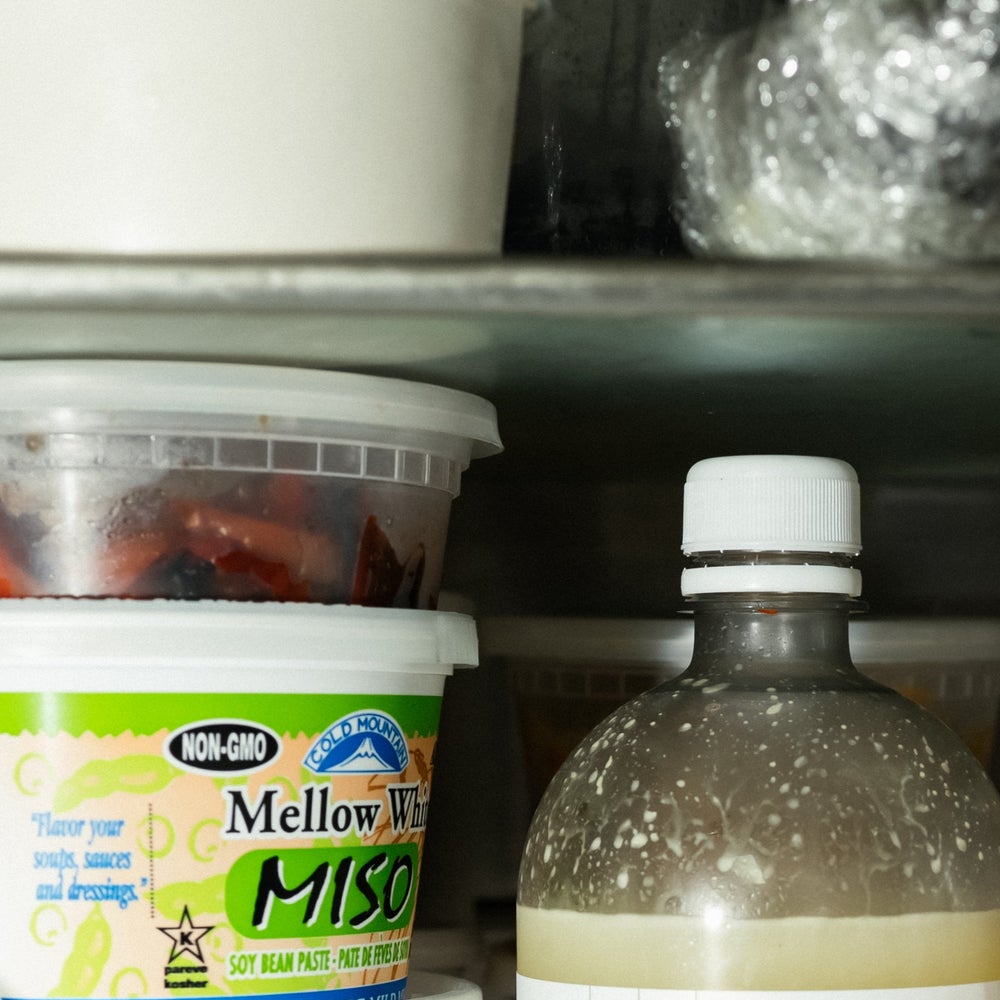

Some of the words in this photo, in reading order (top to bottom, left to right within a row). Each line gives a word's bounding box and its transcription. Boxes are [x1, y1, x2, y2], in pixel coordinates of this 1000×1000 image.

[182, 732, 267, 761] NON-GMO
[310, 722, 352, 764] COLD
[357, 717, 408, 764] MOUNTAIN
[226, 786, 381, 833] Mellow
[88, 820, 124, 845] your
[33, 849, 78, 878] soups,
[84, 852, 131, 869] sauces
[36, 874, 63, 900] and
[252, 852, 414, 931] MISO
[164, 966, 208, 976] pareve
[229, 954, 258, 975] SOY
[261, 952, 294, 974] BEAN
[297, 950, 331, 971] PASTE
[338, 947, 361, 969] PATE
[361, 945, 373, 967] DE
[164, 979, 208, 988] kosher
